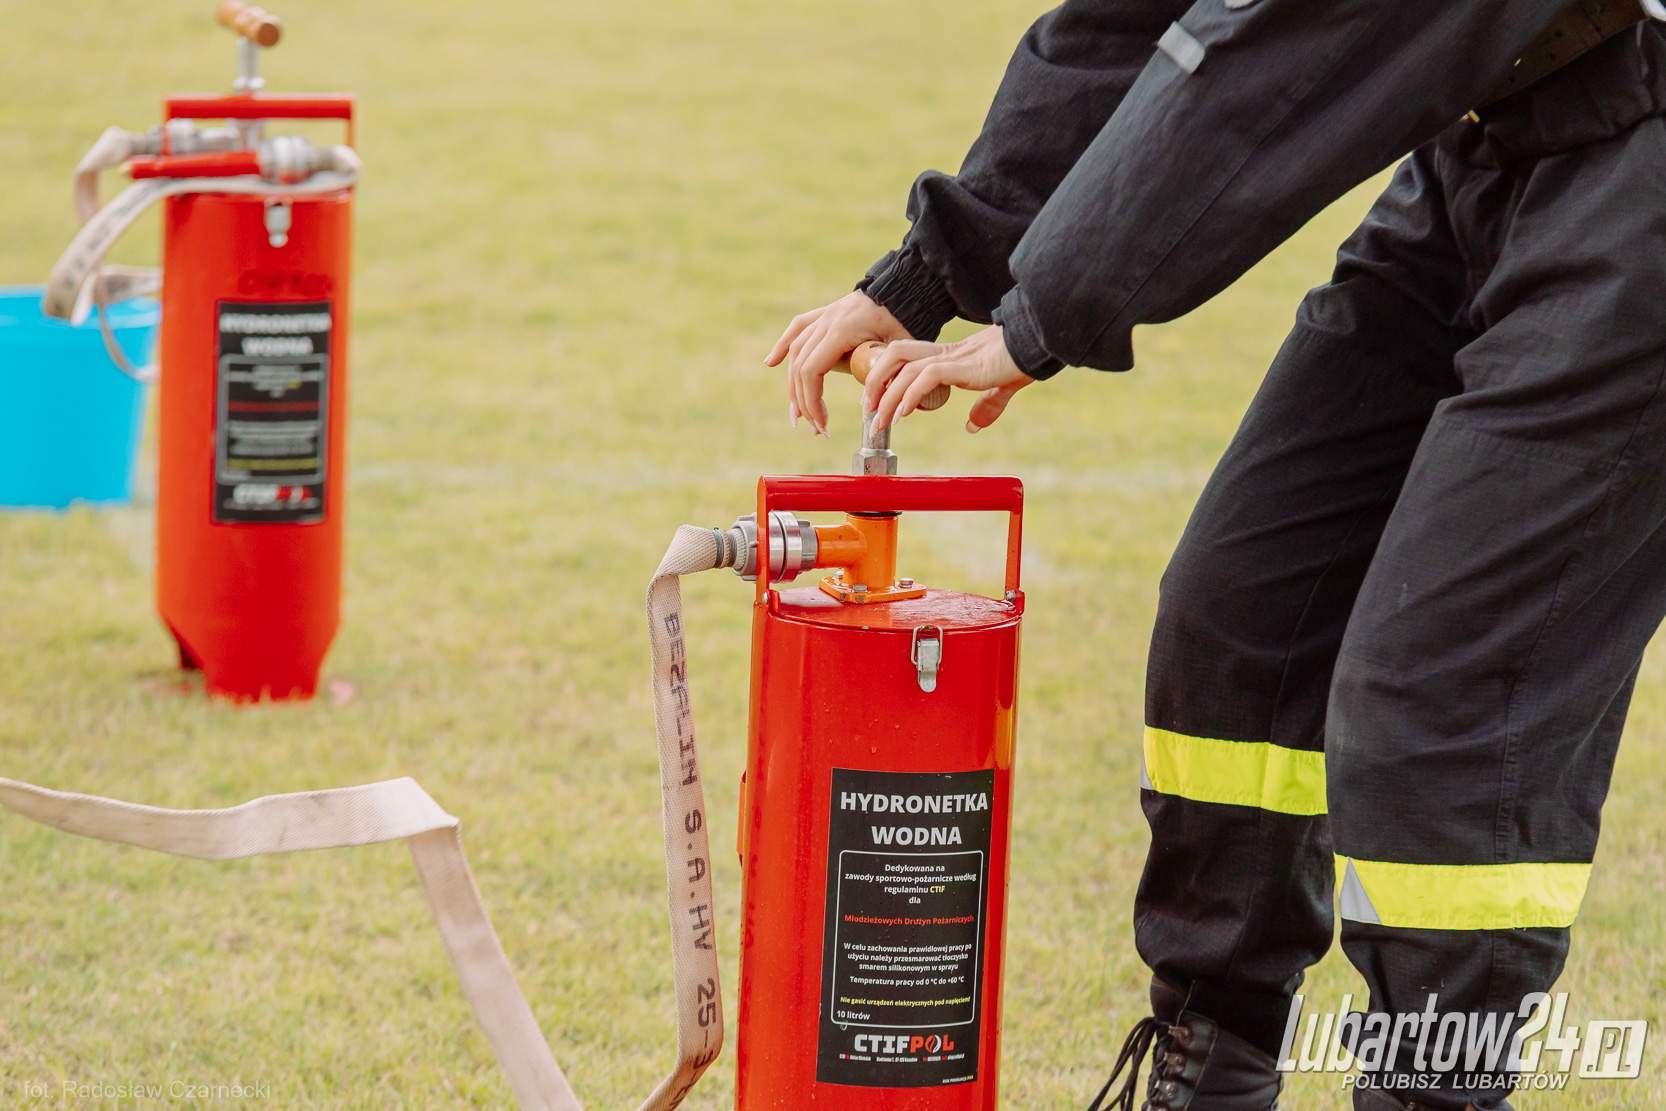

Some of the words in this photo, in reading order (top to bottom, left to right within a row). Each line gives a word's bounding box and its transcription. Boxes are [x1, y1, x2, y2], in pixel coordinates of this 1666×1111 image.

[840, 791, 988, 814] HYDRONETKA
[871, 826, 962, 846] WODNA
[884, 864, 934, 873] Dedykowana
[844, 873, 874, 883] zawody
[875, 873, 953, 884] sportowo-pożarnicze
[884, 885, 929, 895] regulaminu
[929, 885, 945, 894] CTIF
[908, 896, 921, 904] dla
[843, 942, 851, 950] W
[852, 943, 866, 951] celu
[867, 944, 907, 953] zachowania
[948, 943, 964, 953] pracy
[847, 952, 869, 962] użyciu
[870, 953, 893, 964] należy
[888, 963, 930, 973] silikonowym
[938, 963, 959, 973] sprayu
[850, 975, 894, 986] Temperatura
[895, 978, 914, 987] pracy
[915, 976, 924, 985] od
[925, 977, 930, 985] 0
[938, 976, 947, 985] do
[840, 996, 850, 1004] Nie
[836, 1010, 846, 1018] 10
[847, 1010, 870, 1020] litrów
[854, 1033, 955, 1054] CTIFPOL
